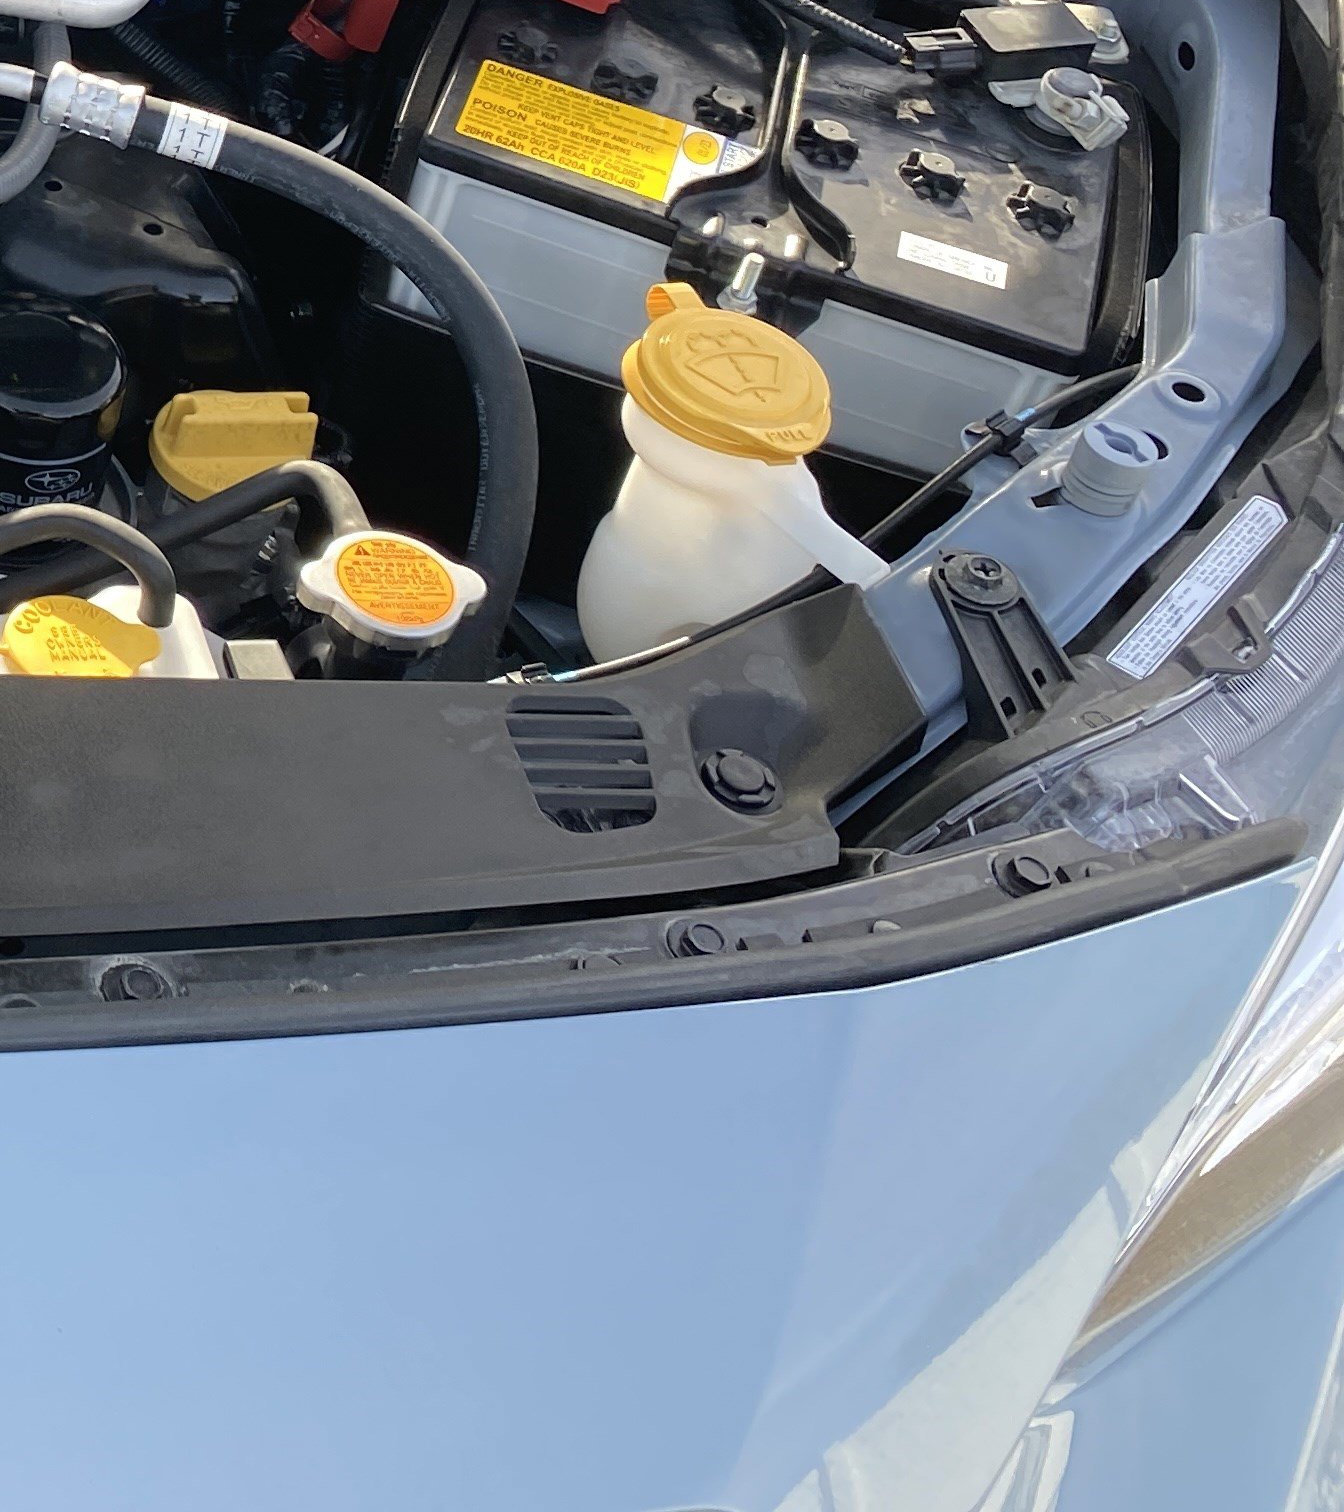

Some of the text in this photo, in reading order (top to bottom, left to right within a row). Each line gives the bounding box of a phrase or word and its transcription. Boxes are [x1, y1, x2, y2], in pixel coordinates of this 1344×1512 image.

[487, 63, 543, 88] DANGER
[547, 83, 592, 104] EXPLOSIVE
[472, 97, 528, 122] POISON
[517, 103, 540, 114] KEEP
[541, 110, 562, 122] VENT
[495, 135, 525, 152] 62Ah
[531, 147, 556, 163] CCA
[0, 482, 93, 507] SUBARU
[14, 599, 116, 635] COOLANT
